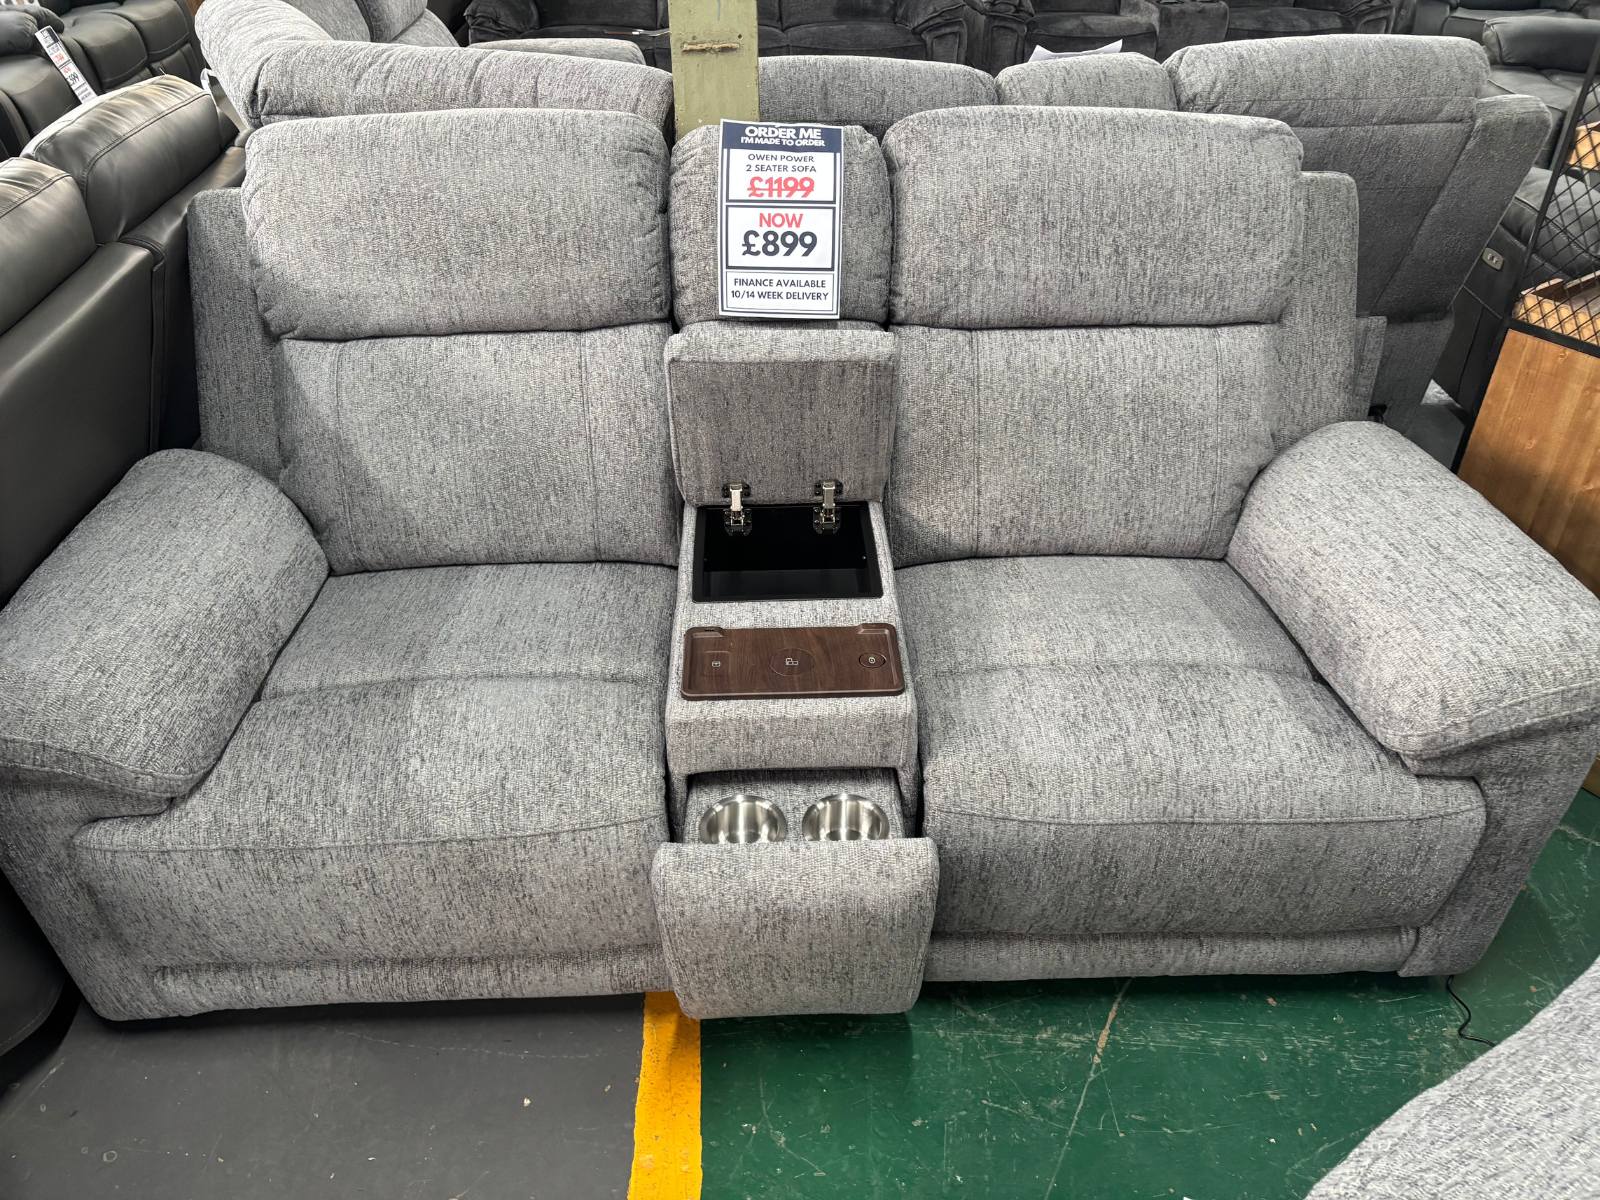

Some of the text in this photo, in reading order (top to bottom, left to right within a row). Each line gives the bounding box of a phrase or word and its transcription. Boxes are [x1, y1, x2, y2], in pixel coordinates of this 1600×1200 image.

[745, 126, 822, 139] ORDER ME
[747, 176, 814, 198] £1199
[759, 212, 804, 228] NOW
[742, 230, 818, 257] £899
[734, 278, 826, 288] FINANCE AVAILABLE
[731, 290, 828, 300] 10/14 WEEK DELIVERY
